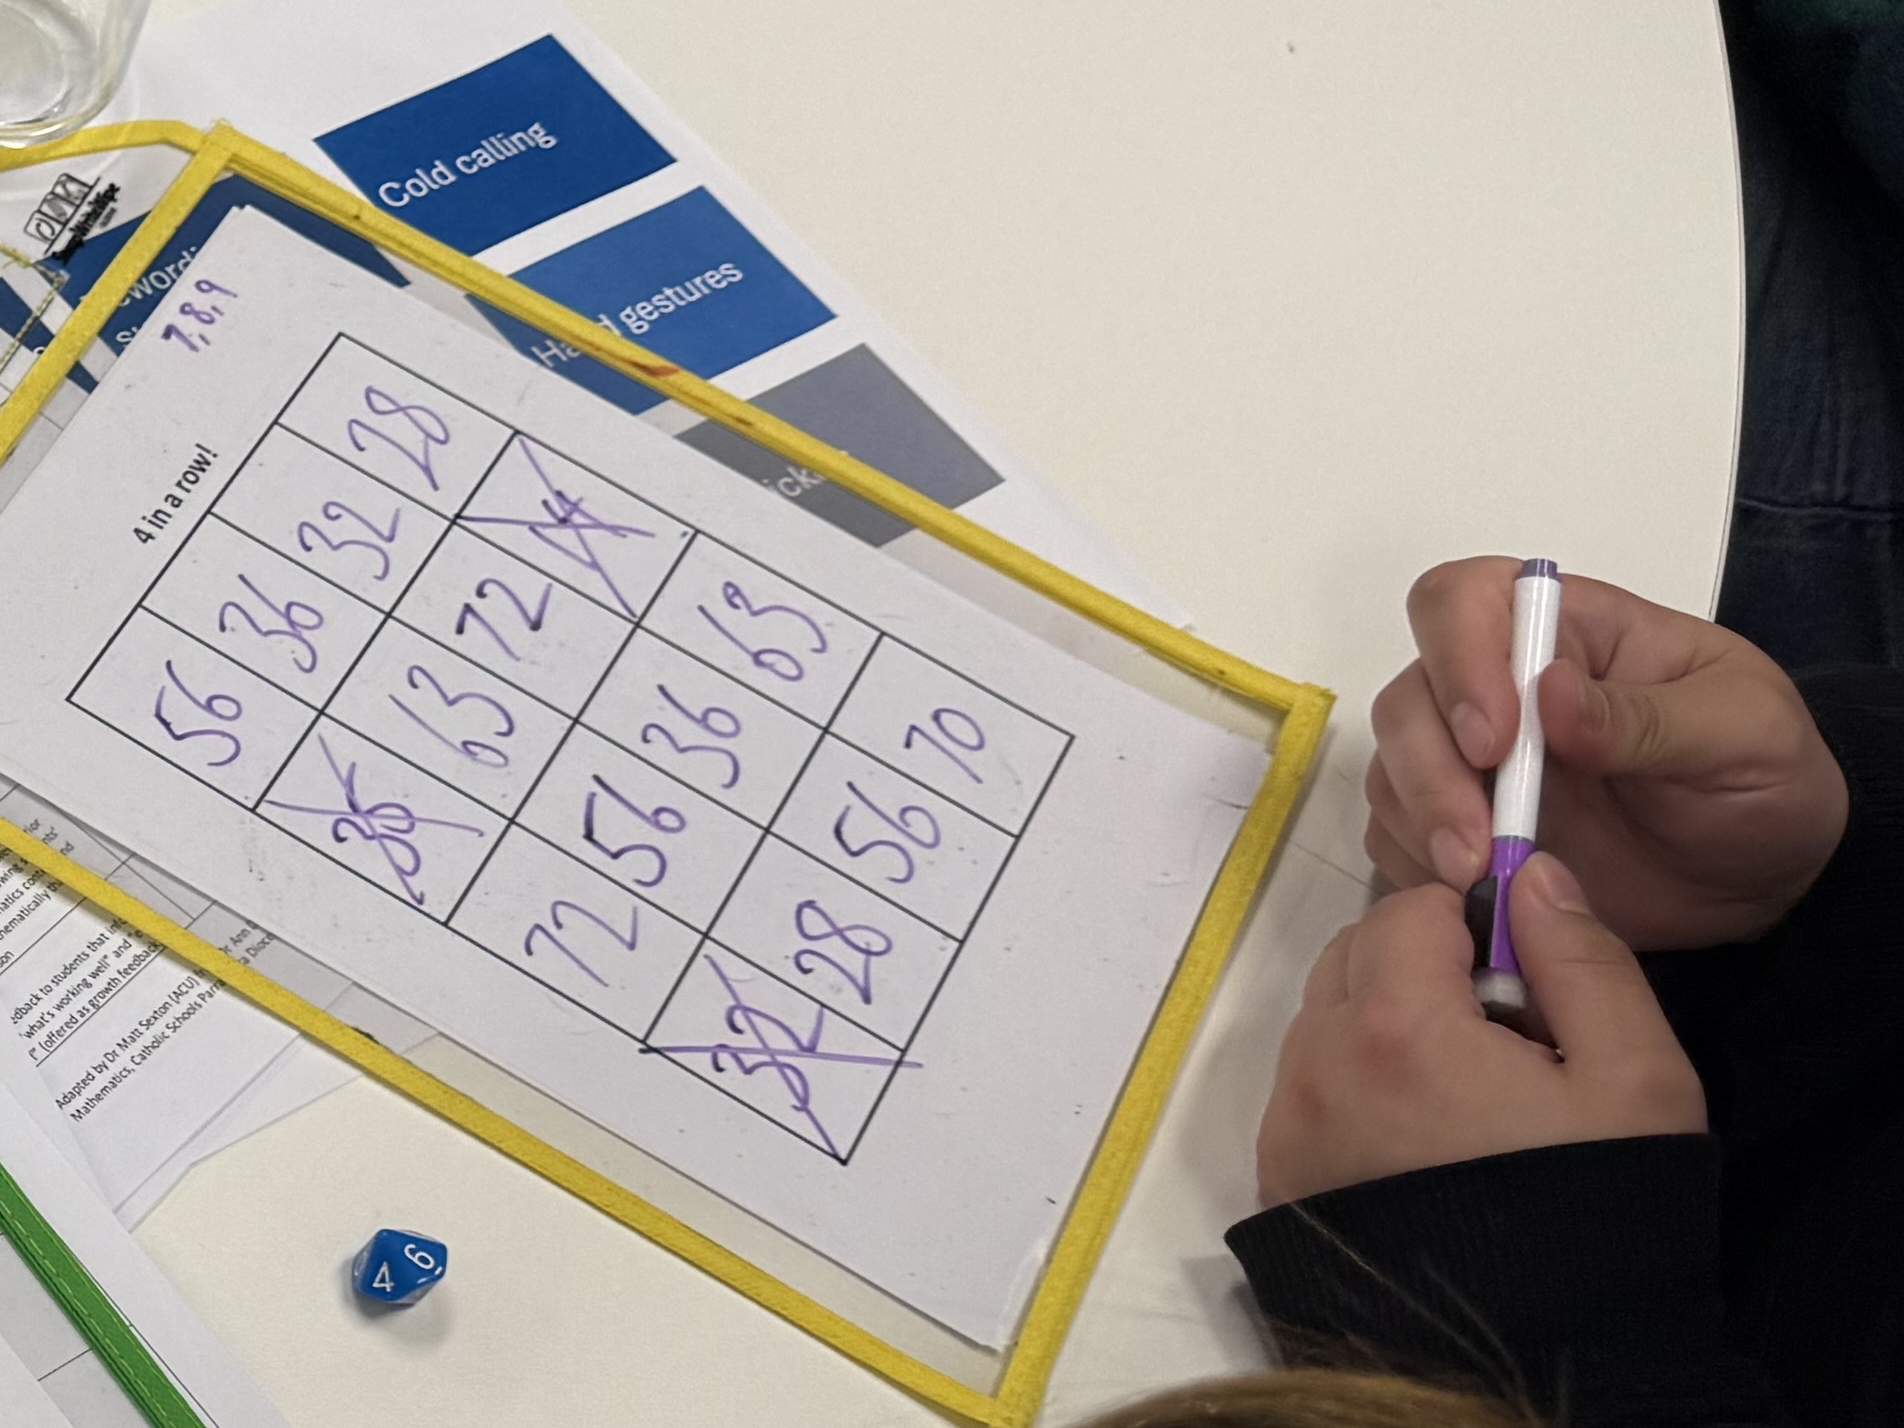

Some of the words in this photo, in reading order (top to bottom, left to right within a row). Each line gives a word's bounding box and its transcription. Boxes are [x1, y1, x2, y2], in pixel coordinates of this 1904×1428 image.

[377, 158, 455, 212] Cold
[451, 120, 558, 182] calling
[531, 310, 625, 372] Had
[623, 258, 744, 334] gestures
[174, 443, 218, 493] row!
[348, 385, 451, 491] 28
[133, 527, 156, 544] 4
[141, 508, 173, 530] in
[164, 493, 183, 508] a
[297, 501, 401, 581] 32
[219, 574, 324, 673] 36
[152, 659, 246, 770] 56
[388, 664, 515, 768] 63
[904, 707, 987, 785] 70
[525, 898, 638, 988] 72
[583, 774, 688, 887] 56
[640, 684, 742, 789] 36
[698, 580, 829, 682] 63
[833, 781, 942, 884] 56
[792, 898, 893, 1006] 28
[55, 1071, 97, 1110] Adapted
[139, 999, 173, 1033] Sexton
[170, 975, 201, 1007] (ACU)
[70, 1064, 136, 1123] Mathematics,
[132, 1027, 171, 1066] Catholic
[372, 1261, 394, 1292] 4
